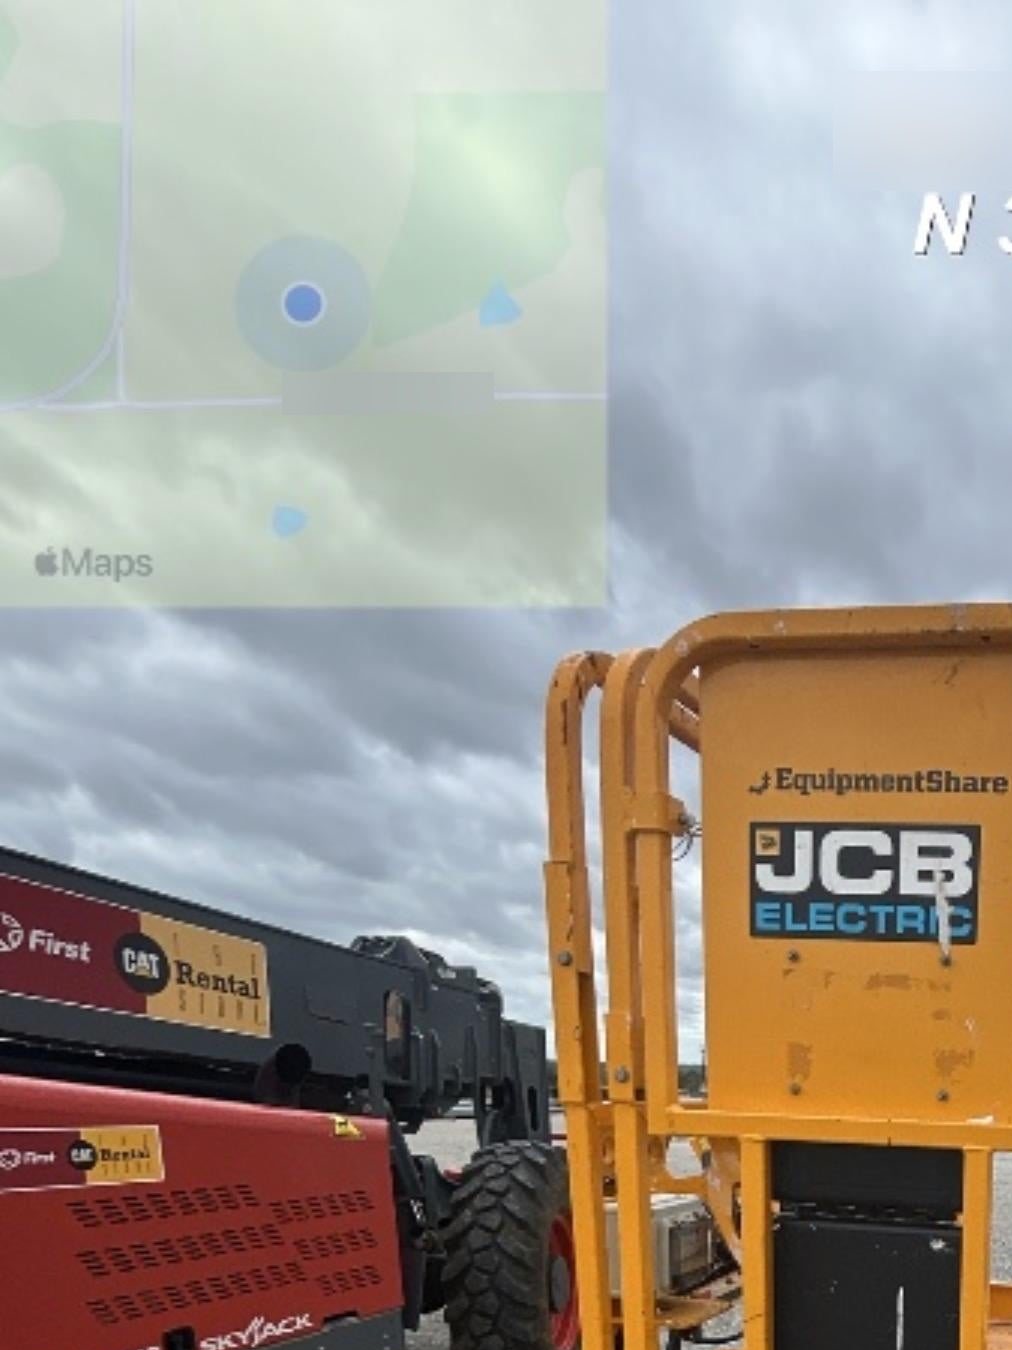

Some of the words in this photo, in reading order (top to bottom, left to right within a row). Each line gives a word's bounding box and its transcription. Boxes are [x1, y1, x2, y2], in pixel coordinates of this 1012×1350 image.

[775, 767, 1009, 795] EquipmentShare
[755, 829, 974, 898] JCB
[755, 902, 974, 938] ELECTRIC
[29, 929, 92, 963] First
[122, 948, 160, 978] CAT
[173, 959, 261, 1000] Rental
